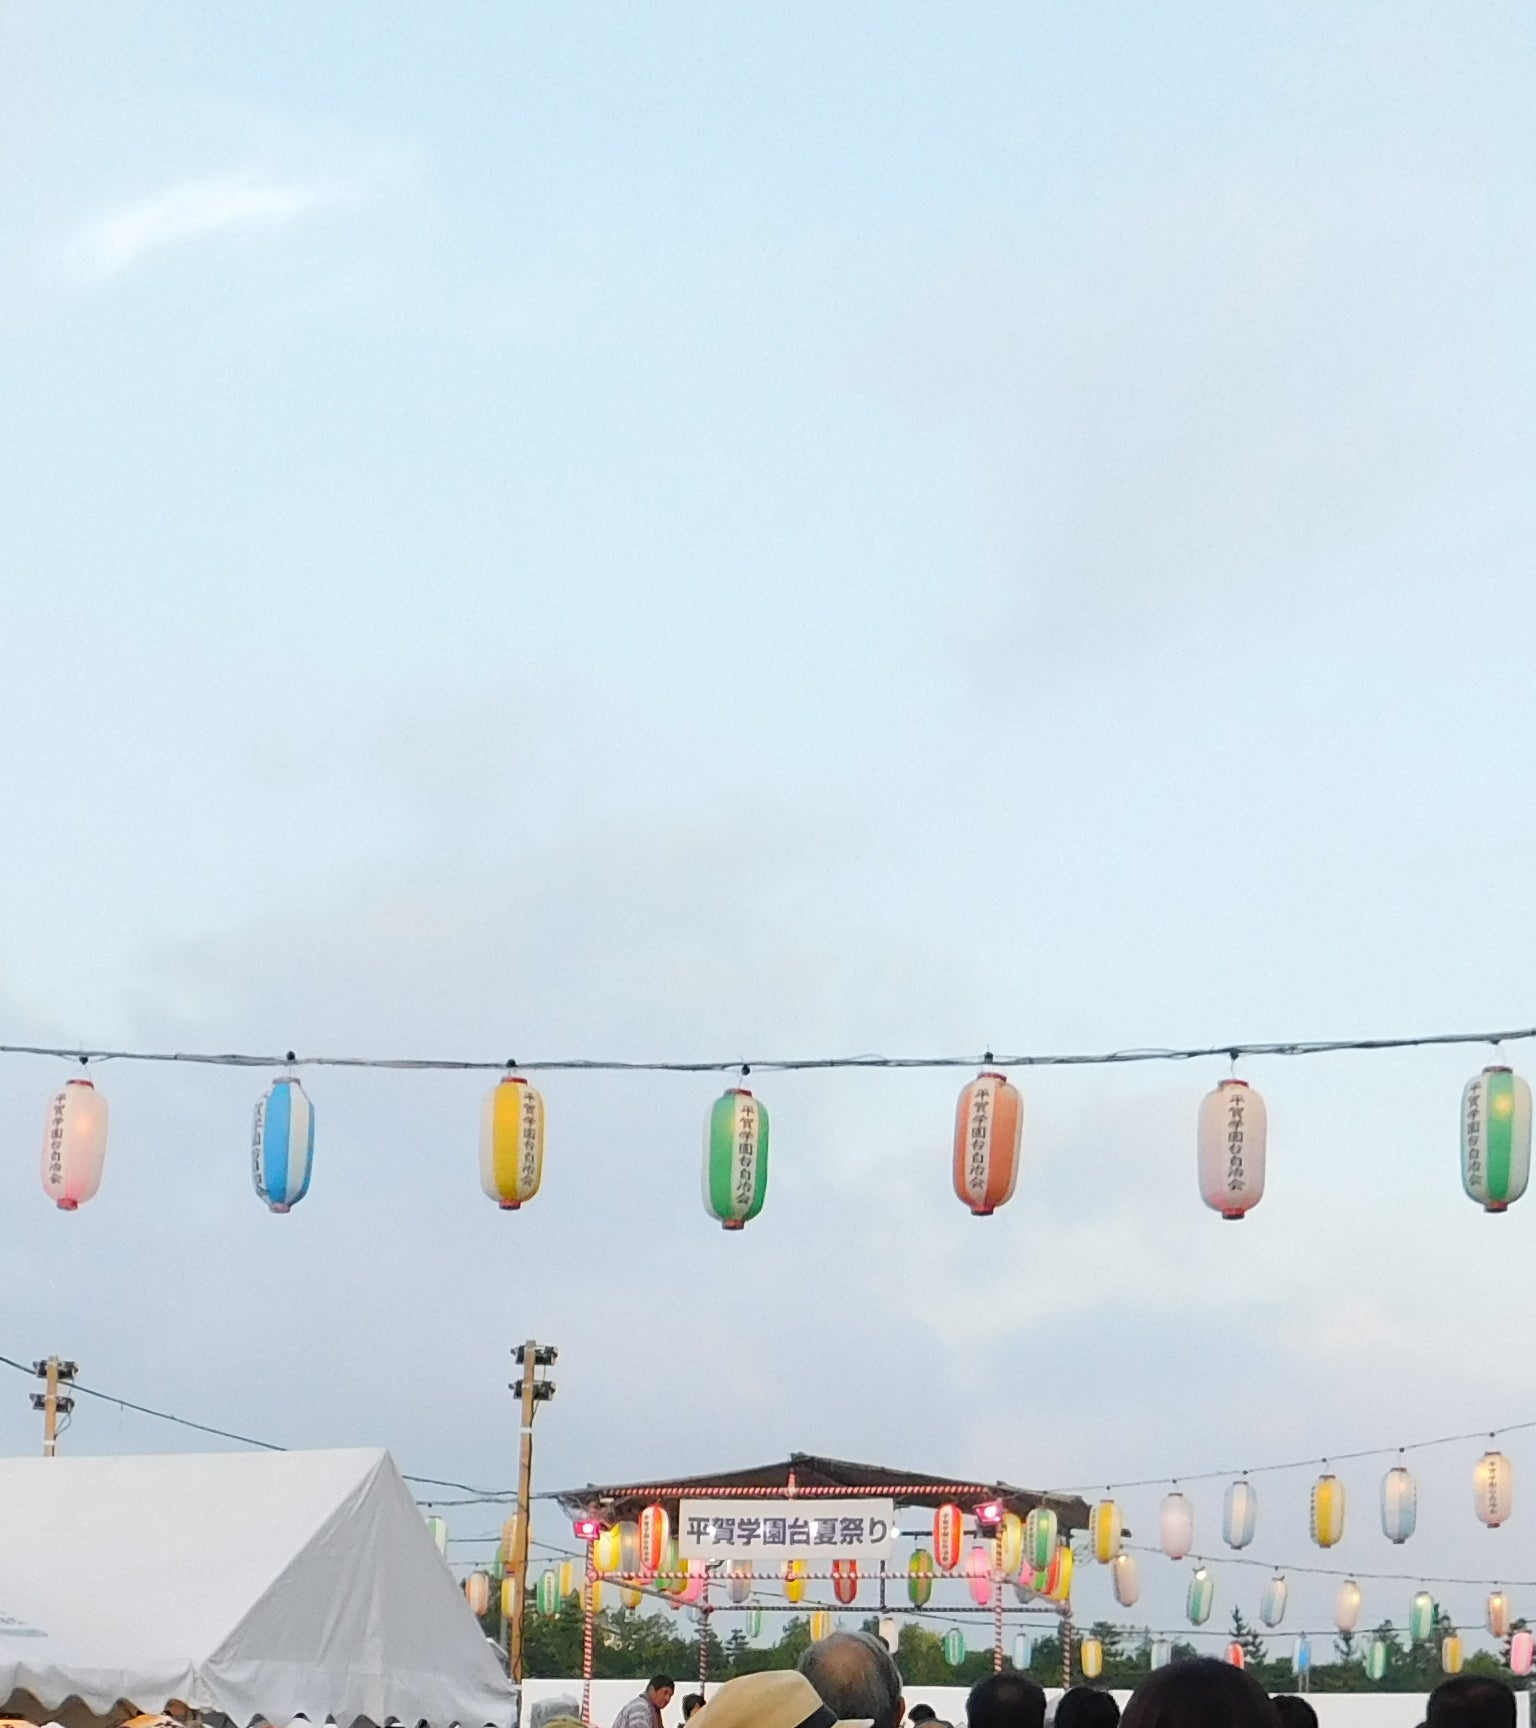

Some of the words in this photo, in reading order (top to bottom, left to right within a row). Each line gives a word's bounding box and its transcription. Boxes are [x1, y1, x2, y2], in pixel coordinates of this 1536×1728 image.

[735, 1103, 755, 1206] 平賀学園台自治会
[969, 1088, 990, 1190] 平賀学園台自治会
[1227, 1093, 1246, 1191] 平賀学園台自治会
[686, 1515, 888, 1546] 平賀学園台夏祭り
